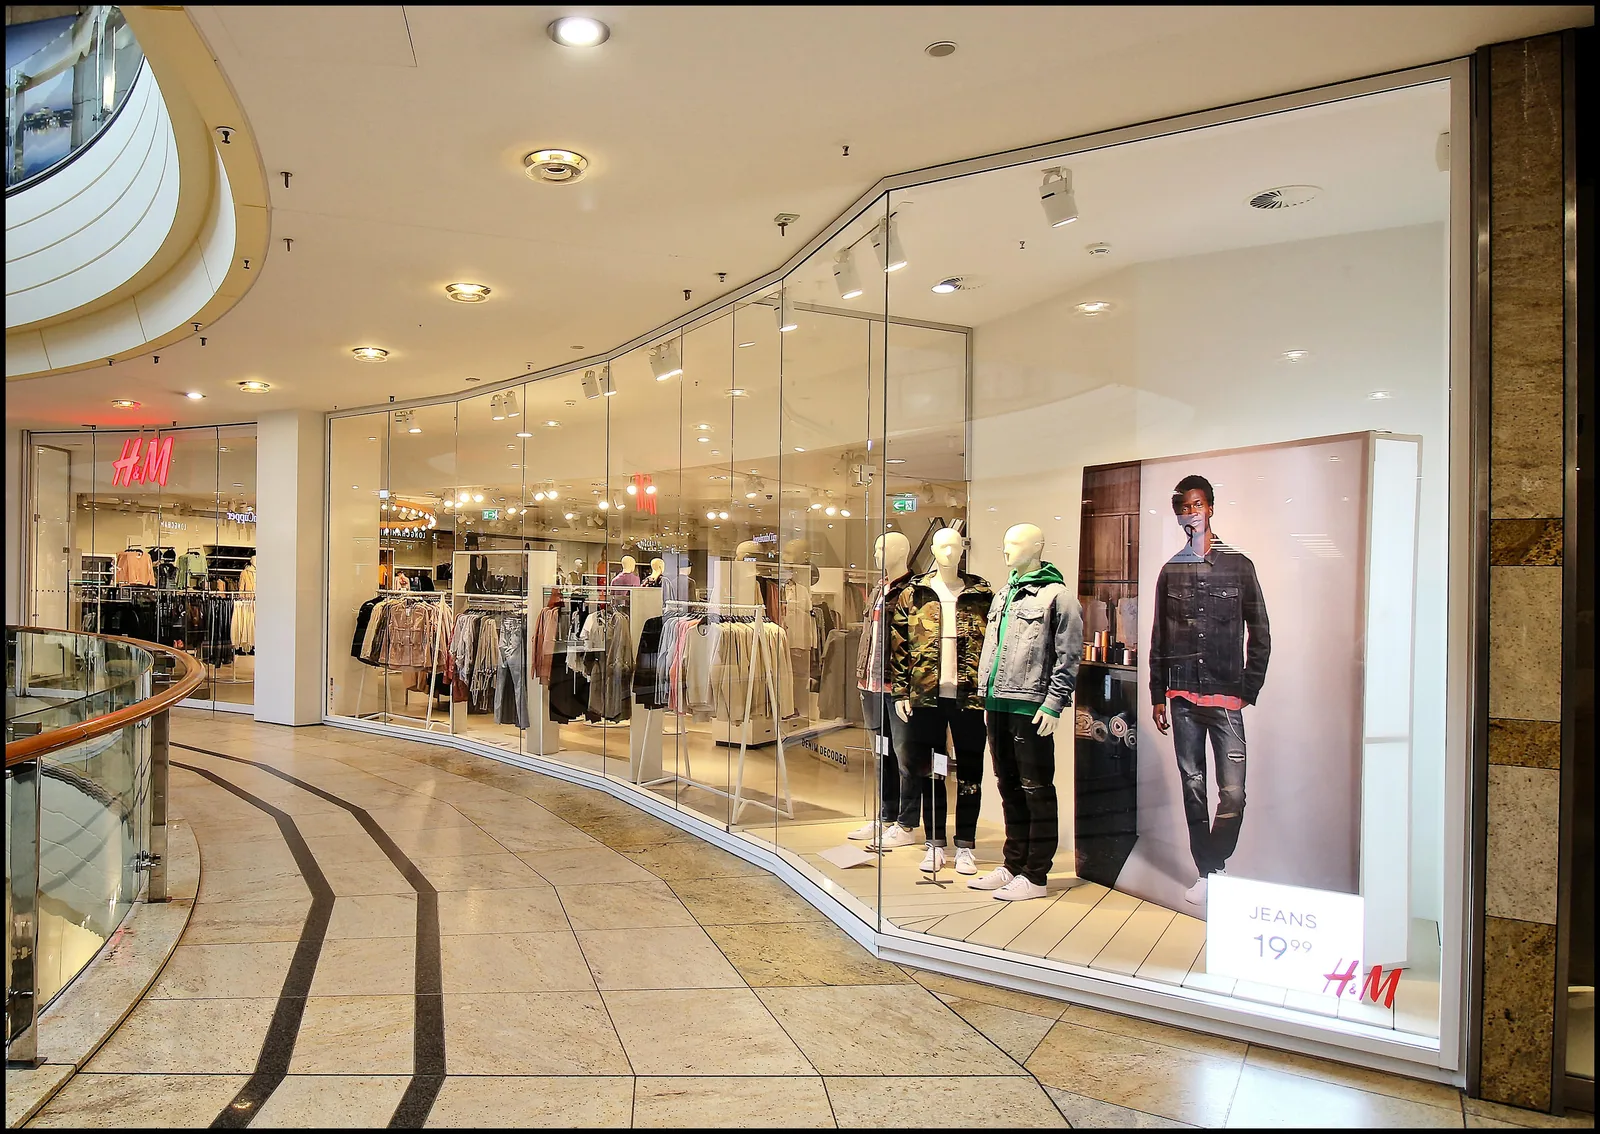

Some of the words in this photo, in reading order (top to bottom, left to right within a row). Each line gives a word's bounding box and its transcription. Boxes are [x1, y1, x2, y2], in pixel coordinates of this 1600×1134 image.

[112, 436, 174, 487] H&M
[820, 745, 847, 765] DECODED
[1249, 906, 1317, 929] JEANS
[1323, 958, 1403, 1009] H&M
